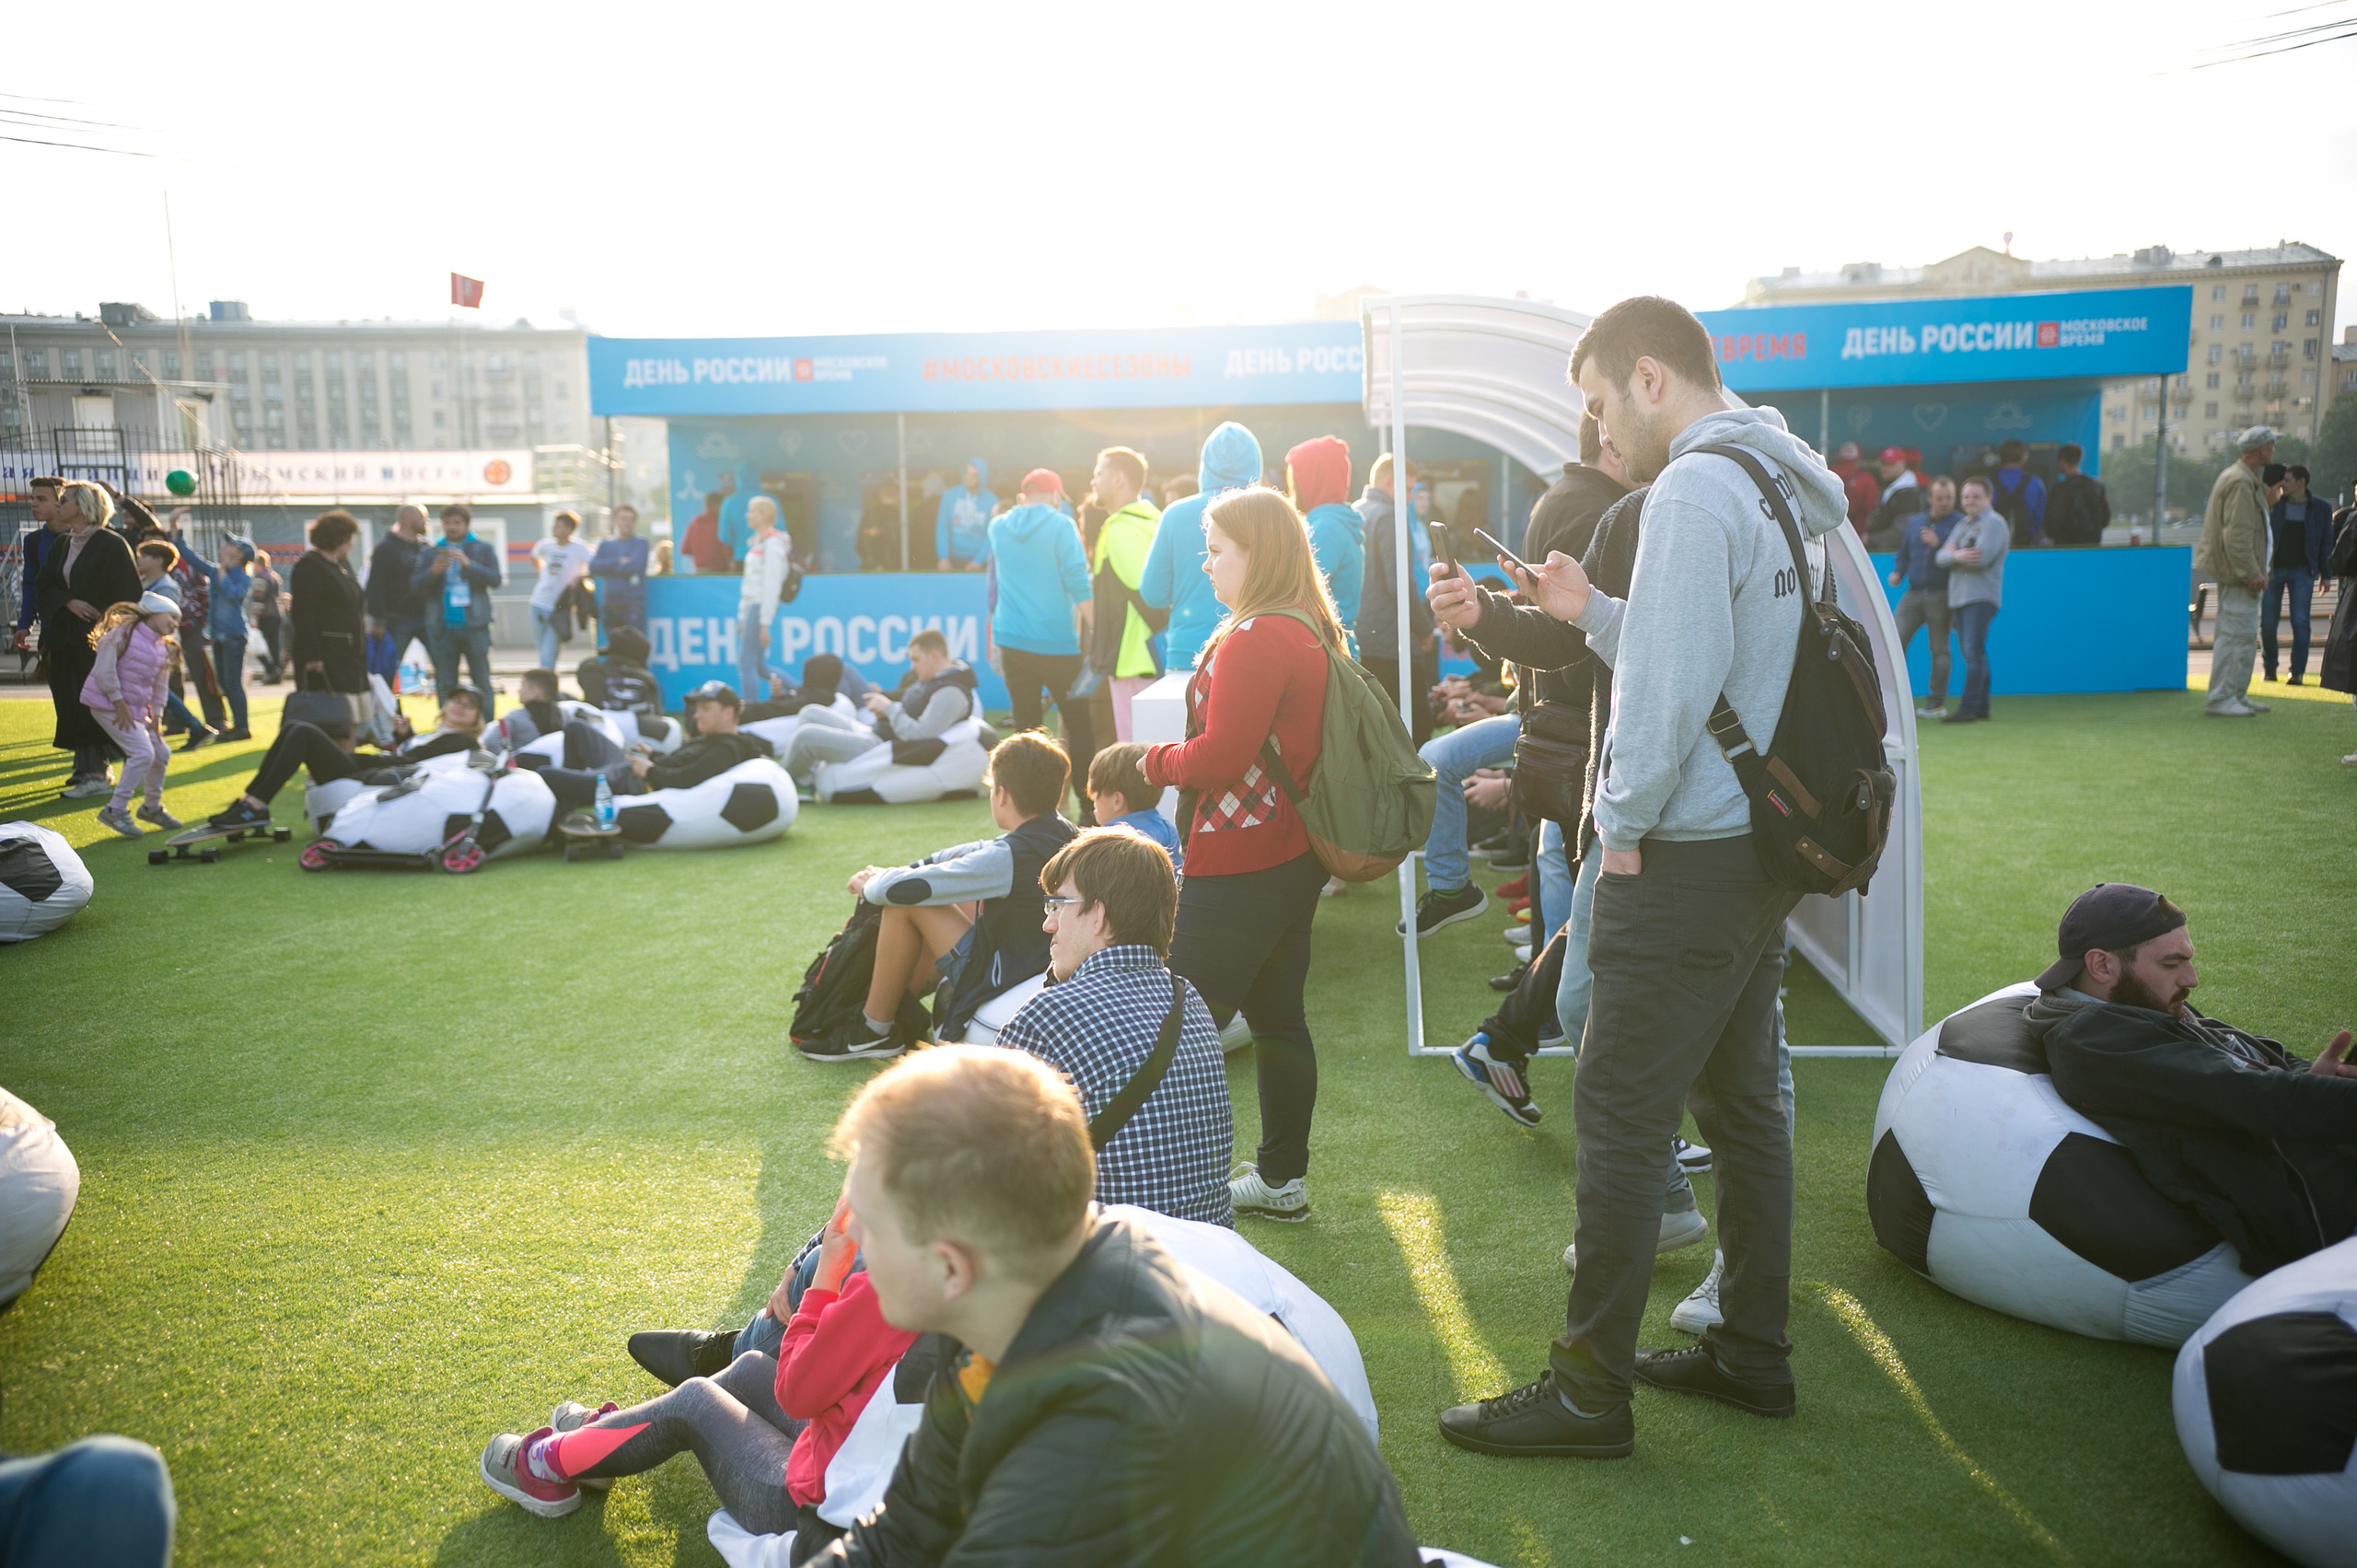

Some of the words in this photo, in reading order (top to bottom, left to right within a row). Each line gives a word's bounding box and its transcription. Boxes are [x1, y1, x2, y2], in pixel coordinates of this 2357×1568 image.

[1841, 326, 1916, 360] ДЕНЬ
[1922, 319, 2034, 354] РОССИИ
[2060, 331, 2106, 347] ВРЕМЯ
[2061, 316, 2148, 333] МОСКОВСКОЕ
[623, 358, 690, 389] ДЕНЬ
[693, 356, 792, 384] РОССИИ
[922, 353, 1192, 382] #МОСКОВСКИЕСЕЗОНЫ
[1225, 348, 1292, 379] ДЕНЬ
[647, 617, 772, 672] ДЕН
